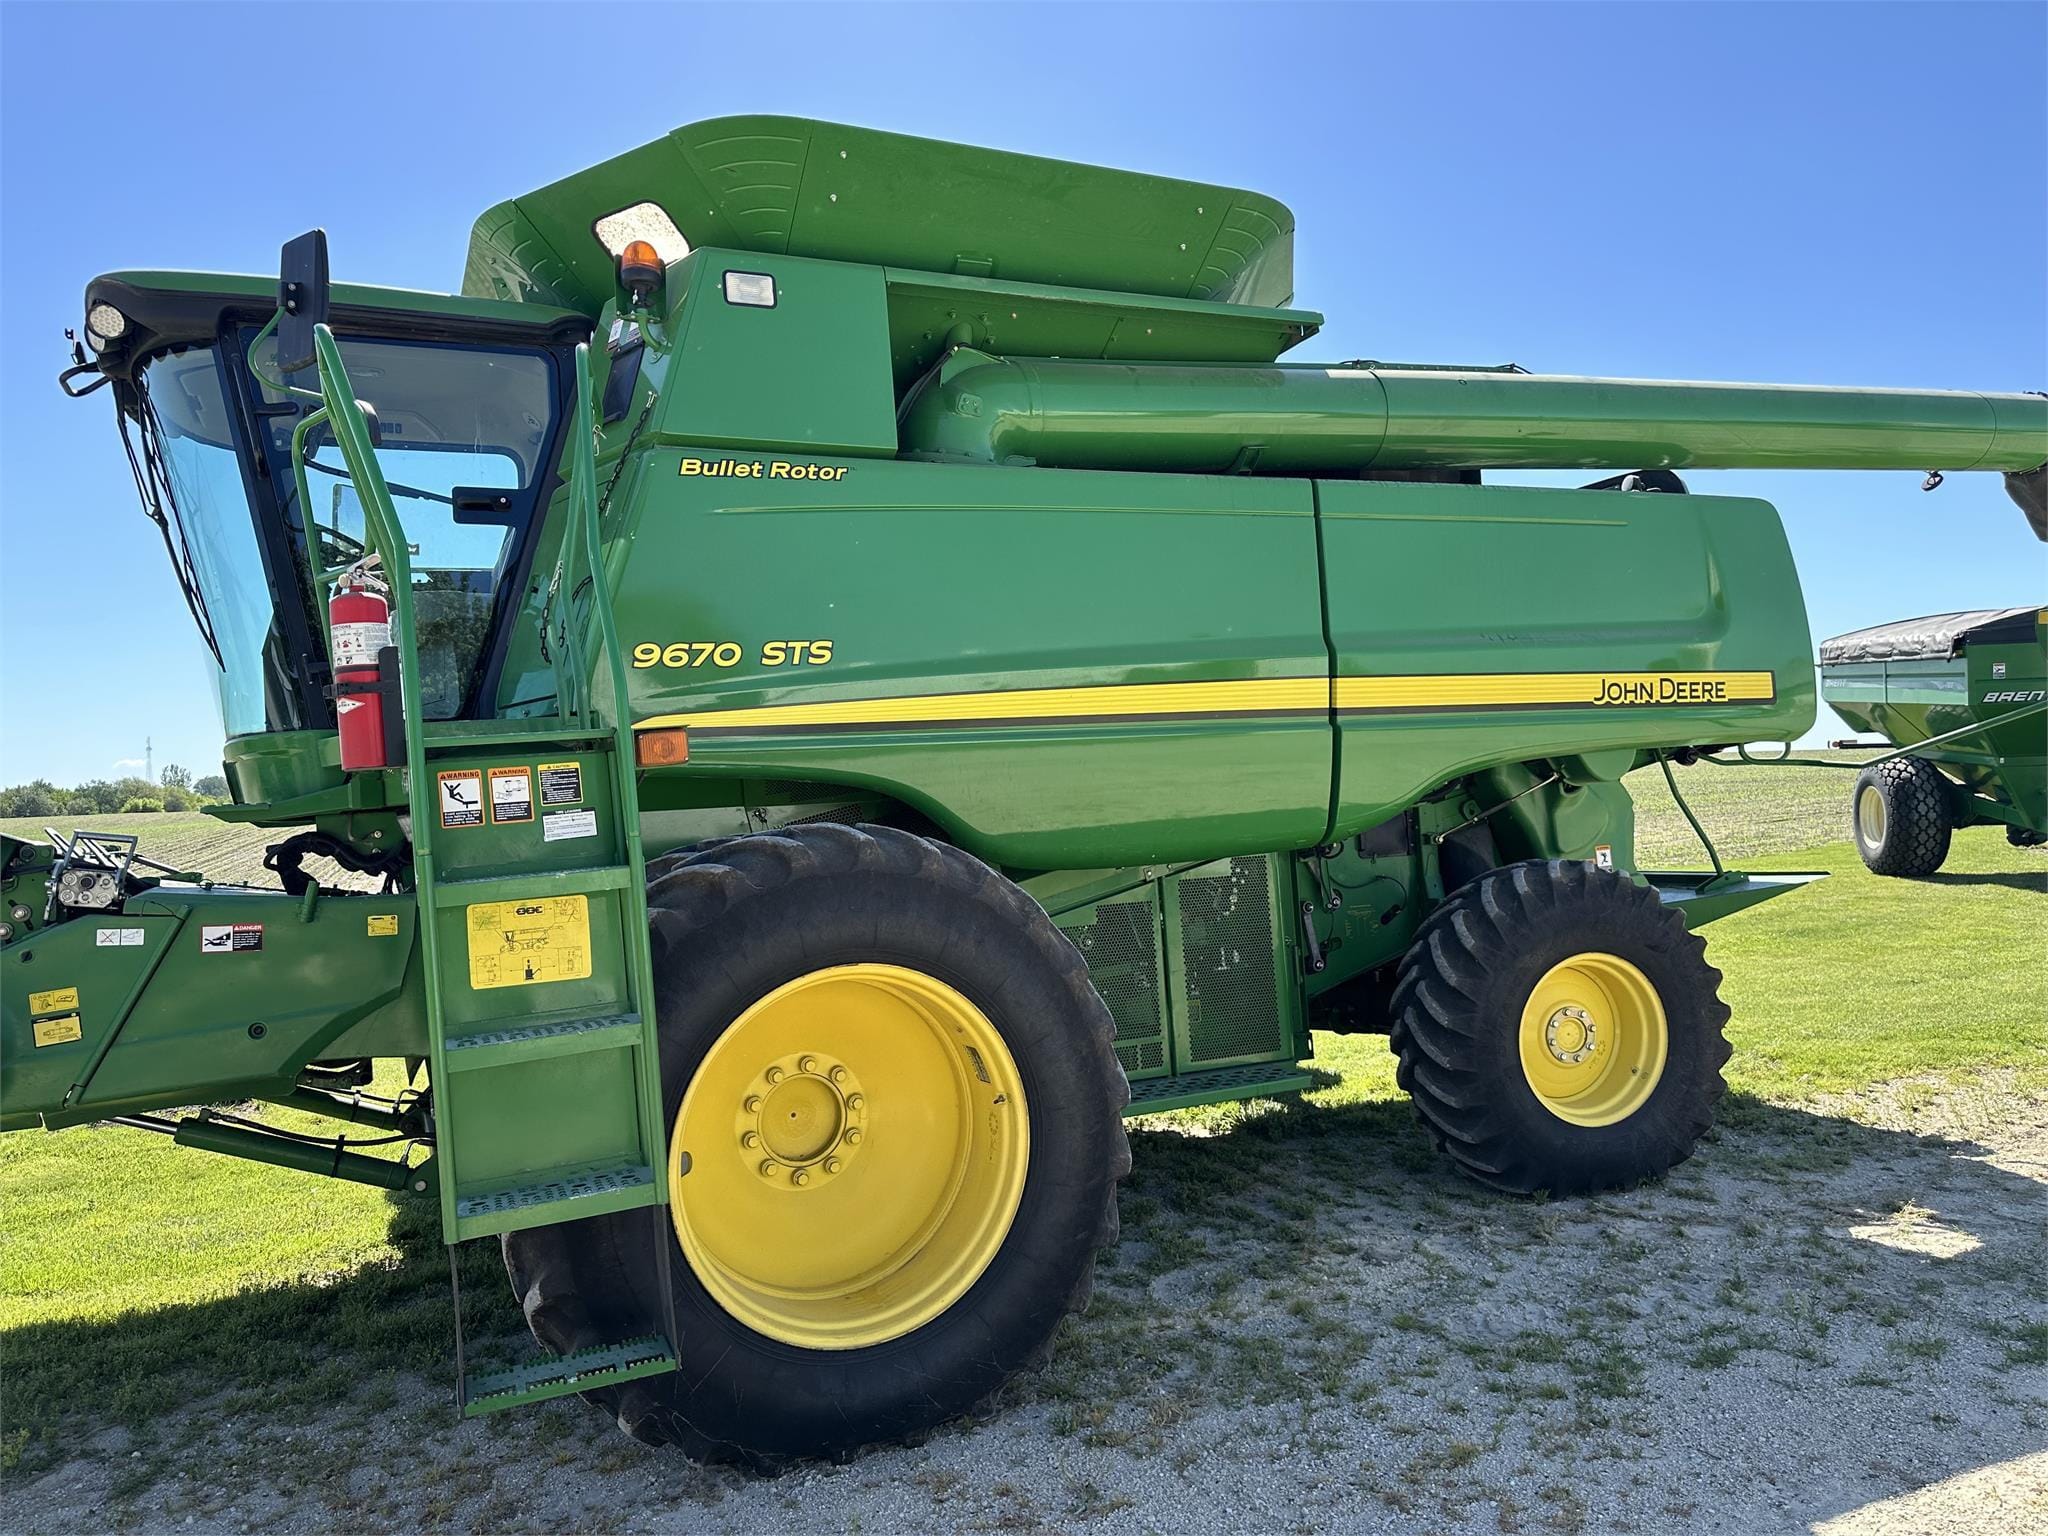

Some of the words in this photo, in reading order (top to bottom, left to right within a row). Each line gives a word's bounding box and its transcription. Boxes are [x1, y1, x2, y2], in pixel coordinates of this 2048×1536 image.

[679, 458, 764, 478] Bullet
[769, 461, 848, 481] Rotor
[632, 641, 742, 668] 9670
[760, 639, 834, 666] STS
[1593, 678, 1653, 702] JOHN
[1659, 678, 1727, 702] DEERE
[447, 771, 480, 780] WARNING
[498, 768, 528, 776] WARNING
